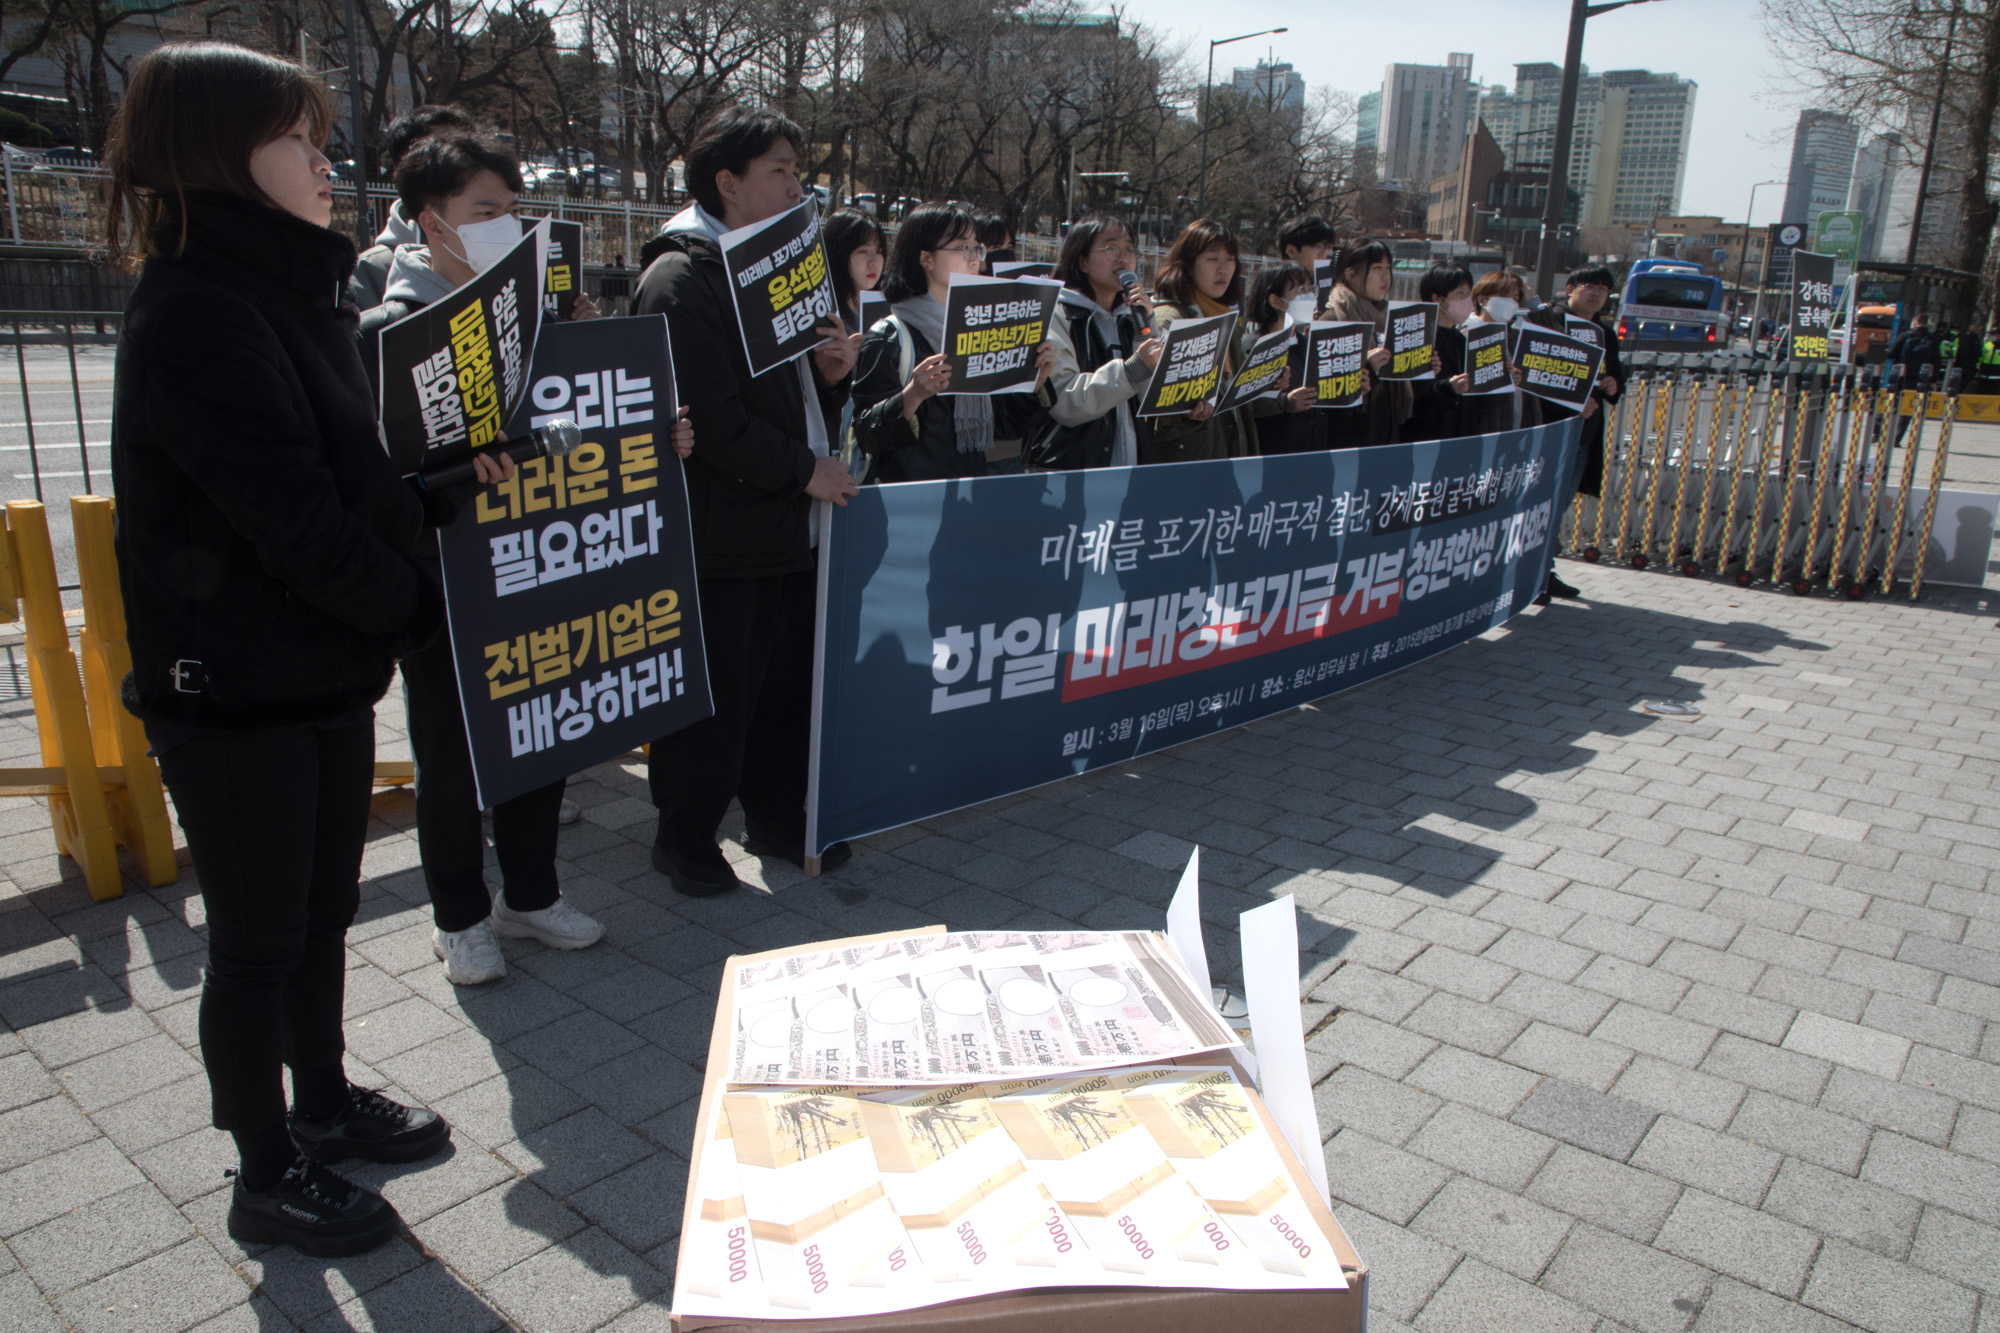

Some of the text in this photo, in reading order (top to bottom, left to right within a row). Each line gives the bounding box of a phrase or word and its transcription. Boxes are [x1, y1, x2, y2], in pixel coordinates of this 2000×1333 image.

[737, 255, 774, 288] 미래를
[772, 236, 803, 268] 포기한
[1686, 289, 1704, 301] 740
[964, 299, 1042, 327] 청년 모욕하는
[1393, 312, 1426, 335] 강제동원
[492, 278, 522, 411] 청년 모욕하는
[956, 320, 1043, 356] 미래청년기금
[1171, 328, 1219, 362] 강제동원
[1317, 333, 1363, 358] 강제동원
[1394, 329, 1425, 353] 굴욕해법
[1530, 340, 1588, 363] 청년 모욕하는
[449, 298, 500, 448] 미래청년기금
[966, 346, 1029, 379] 필요없다!
[1164, 351, 1215, 384] 굴욕해법
[1318, 352, 1362, 378] 굴욕해법
[1522, 353, 1590, 380] 미래청년기금
[1526, 368, 1579, 392] 필요없다!
[411, 346, 466, 450] 필요없다!
[531, 367, 654, 430] 우리는
[619, 432, 659, 494] 돈
[489, 499, 664, 598] 필요없다
[1040, 518, 1146, 581] 미래를
[1148, 504, 1244, 561] 포기한
[1247, 493, 1323, 550] 매국적
[1326, 487, 1372, 538] 결단,
[931, 498, 1552, 715] 한일 미래청년기금 거부 청년학생 기자회견
[484, 588, 682, 701] 전범기업은
[507, 647, 685, 758] 배상하라!
[1062, 726, 1095, 757] 일시
[1108, 716, 1134, 742] 3월
[1139, 699, 1194, 733] 16일(목)
[1260, 675, 1284, 699] 장소
[1292, 666, 1317, 689] 용산
[1316, 655, 1349, 682] 집무실
[1348, 653, 1361, 673] 앞
[783, 1085, 849, 1100] 50000 won
[1000, 1080, 1025, 1091] won
[1071, 1076, 1108, 1097] 50000
[1127, 1072, 1151, 1084] won
[1176, 1083, 1197, 1096] won
[1198, 1071, 1232, 1090] 50000
[911, 1083, 975, 1108] 50000 won
[1048, 1091, 1070, 1103] won
[957, 1220, 987, 1266] 50000
[1117, 1214, 1155, 1261] 50000
[1269, 1213, 1312, 1260] 50000
[728, 1226, 748, 1284] 50000
[803, 1243, 829, 1295] 50000
